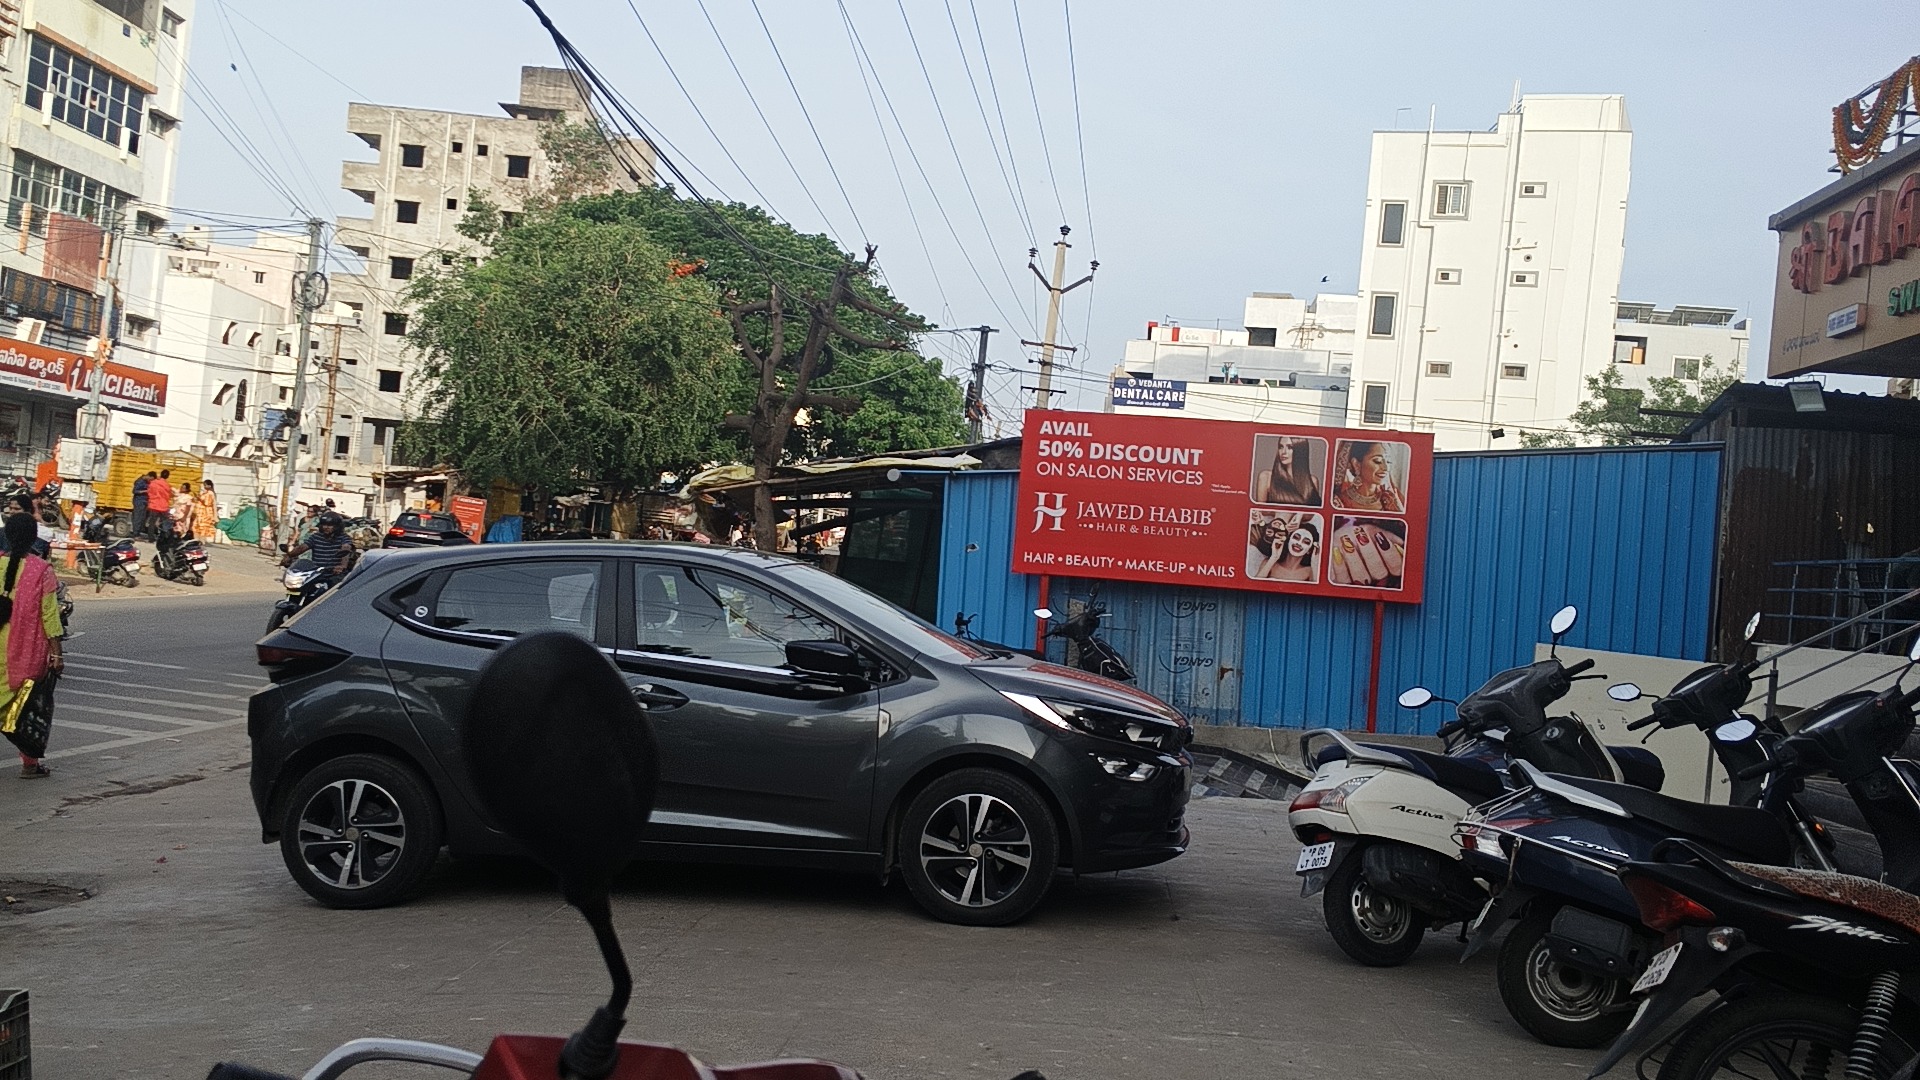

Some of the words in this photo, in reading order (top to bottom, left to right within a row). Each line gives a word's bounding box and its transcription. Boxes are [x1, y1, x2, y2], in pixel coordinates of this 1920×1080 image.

[84, 369, 122, 394] IICI
[122, 379, 160, 403] Bank
[1138, 379, 1172, 389] VEDANTA
[1114, 387, 1154, 400] DENTAL
[1156, 390, 1185, 402] CARE
[1039, 420, 1093, 437] AVAIL
[1038, 439, 1083, 459] 50%
[1089, 443, 1203, 466] DISCOUNT
[1036, 461, 1064, 477] ON
[1066, 462, 1123, 480] SALON
[1127, 467, 1203, 486] SERVICES
[1076, 501, 1144, 520] JAWED
[1096, 522, 1126, 533] HAIR
[1129, 525, 1139, 534] &
[1143, 526, 1190, 538] BEAUTY
[1023, 552, 1055, 564] HAIR
[1065, 554, 1115, 568] BEAUTY
[1124, 558, 1187, 574] MAKE-UP
[1197, 564, 1235, 578] NAILS
[1176, 600, 1217, 612] GANGA
[1173, 655, 1214, 667] GANGA
[1390, 805, 1445, 820] Activa
